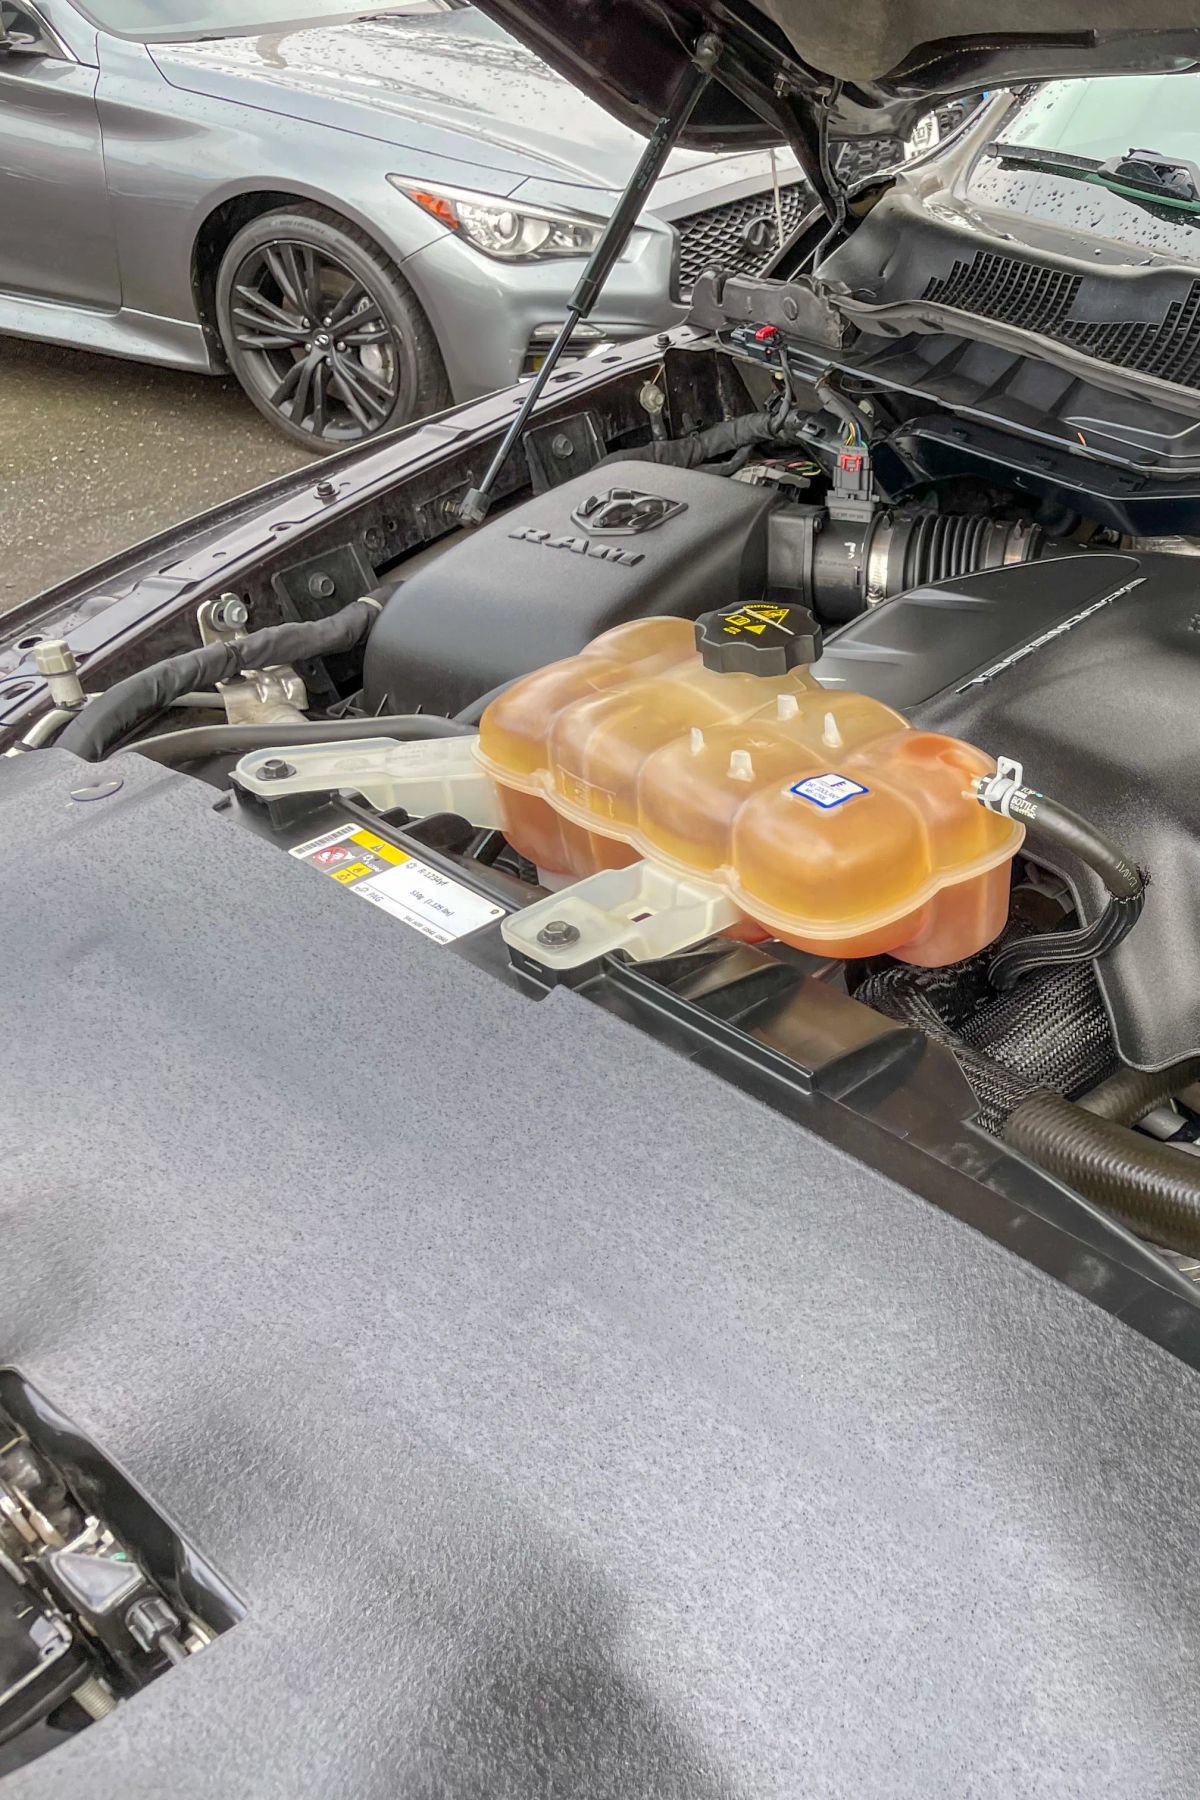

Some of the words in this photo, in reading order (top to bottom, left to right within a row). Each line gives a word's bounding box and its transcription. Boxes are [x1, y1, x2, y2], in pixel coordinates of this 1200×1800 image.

[508, 526, 646, 567] RAM
[1010, 796, 1038, 811] BOTTLE
[416, 867, 448, 887] R-1234yf
[367, 891, 384, 902] PAG
